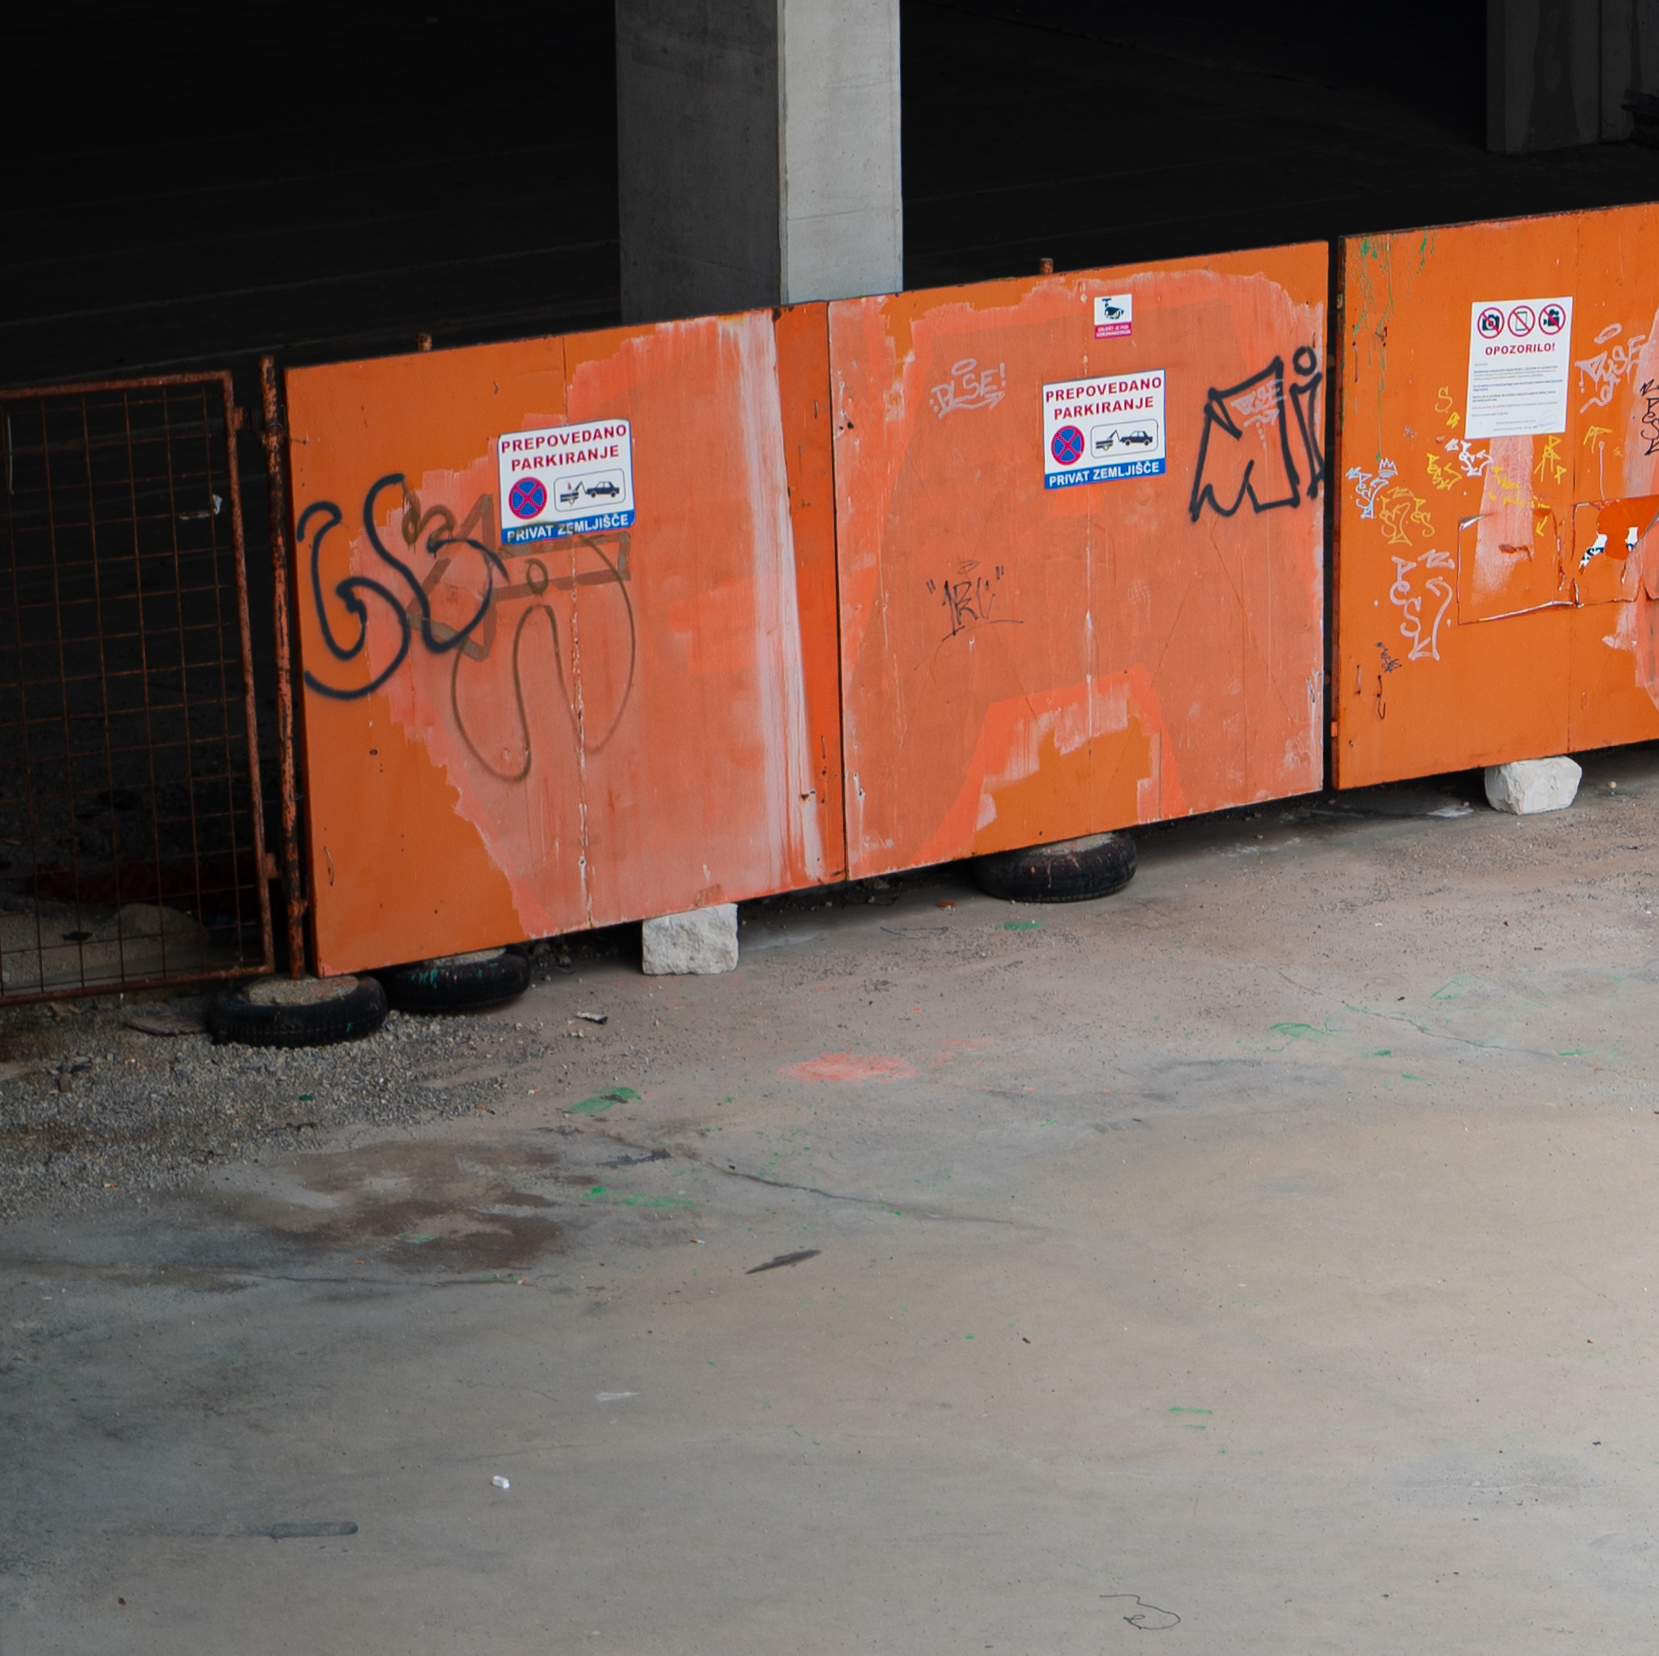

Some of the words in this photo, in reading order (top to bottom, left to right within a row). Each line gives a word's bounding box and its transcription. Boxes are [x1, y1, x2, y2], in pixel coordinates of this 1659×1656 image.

[1485, 343, 1556, 356] OPOZORILO!
[1046, 376, 1162, 403] PREPOVEDANO
[1054, 396, 1154, 420] PARKIRANJE
[501, 424, 627, 454] PREPOVEDANO
[511, 445, 619, 472] PARKIRANJE
[1049, 471, 1090, 487] PRIVAT
[1093, 460, 1160, 480] ZEMLJIŠČE
[506, 525, 554, 543] PRIVAT
[557, 513, 629, 536] ZEMLJIŠČE
